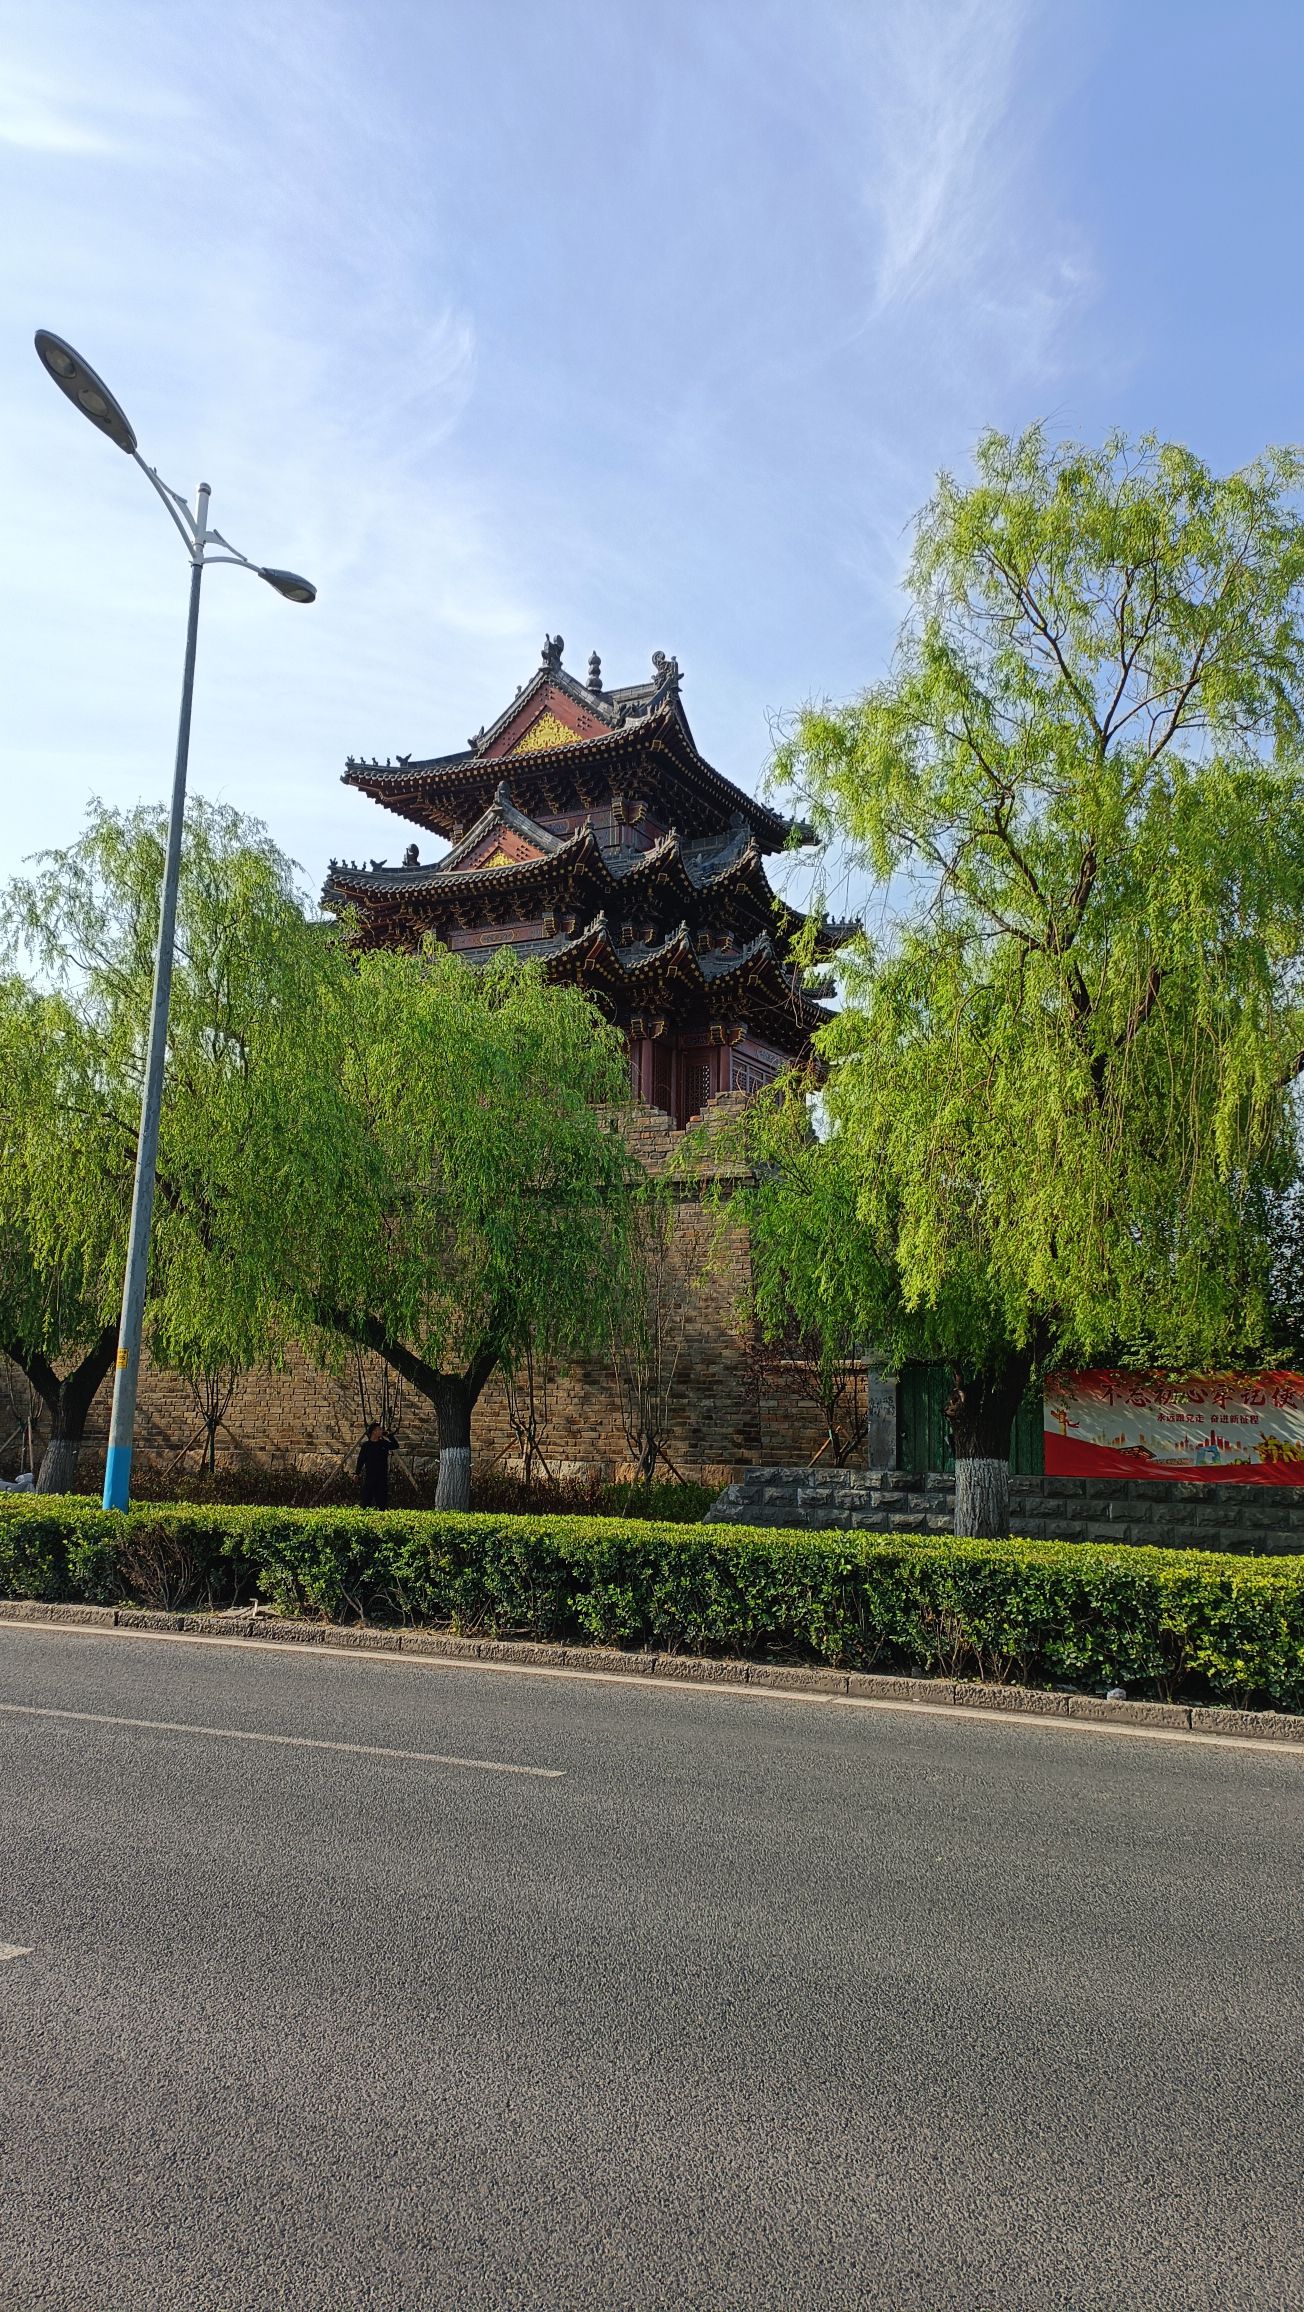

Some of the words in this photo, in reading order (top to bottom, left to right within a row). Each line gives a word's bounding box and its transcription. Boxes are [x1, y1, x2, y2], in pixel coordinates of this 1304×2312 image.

[1101, 1383, 1304, 1409] 不忘初心牢记使
[1156, 1413, 1205, 1424] 永远跟党走
[1210, 1414, 1260, 1425] 奋进新征程
